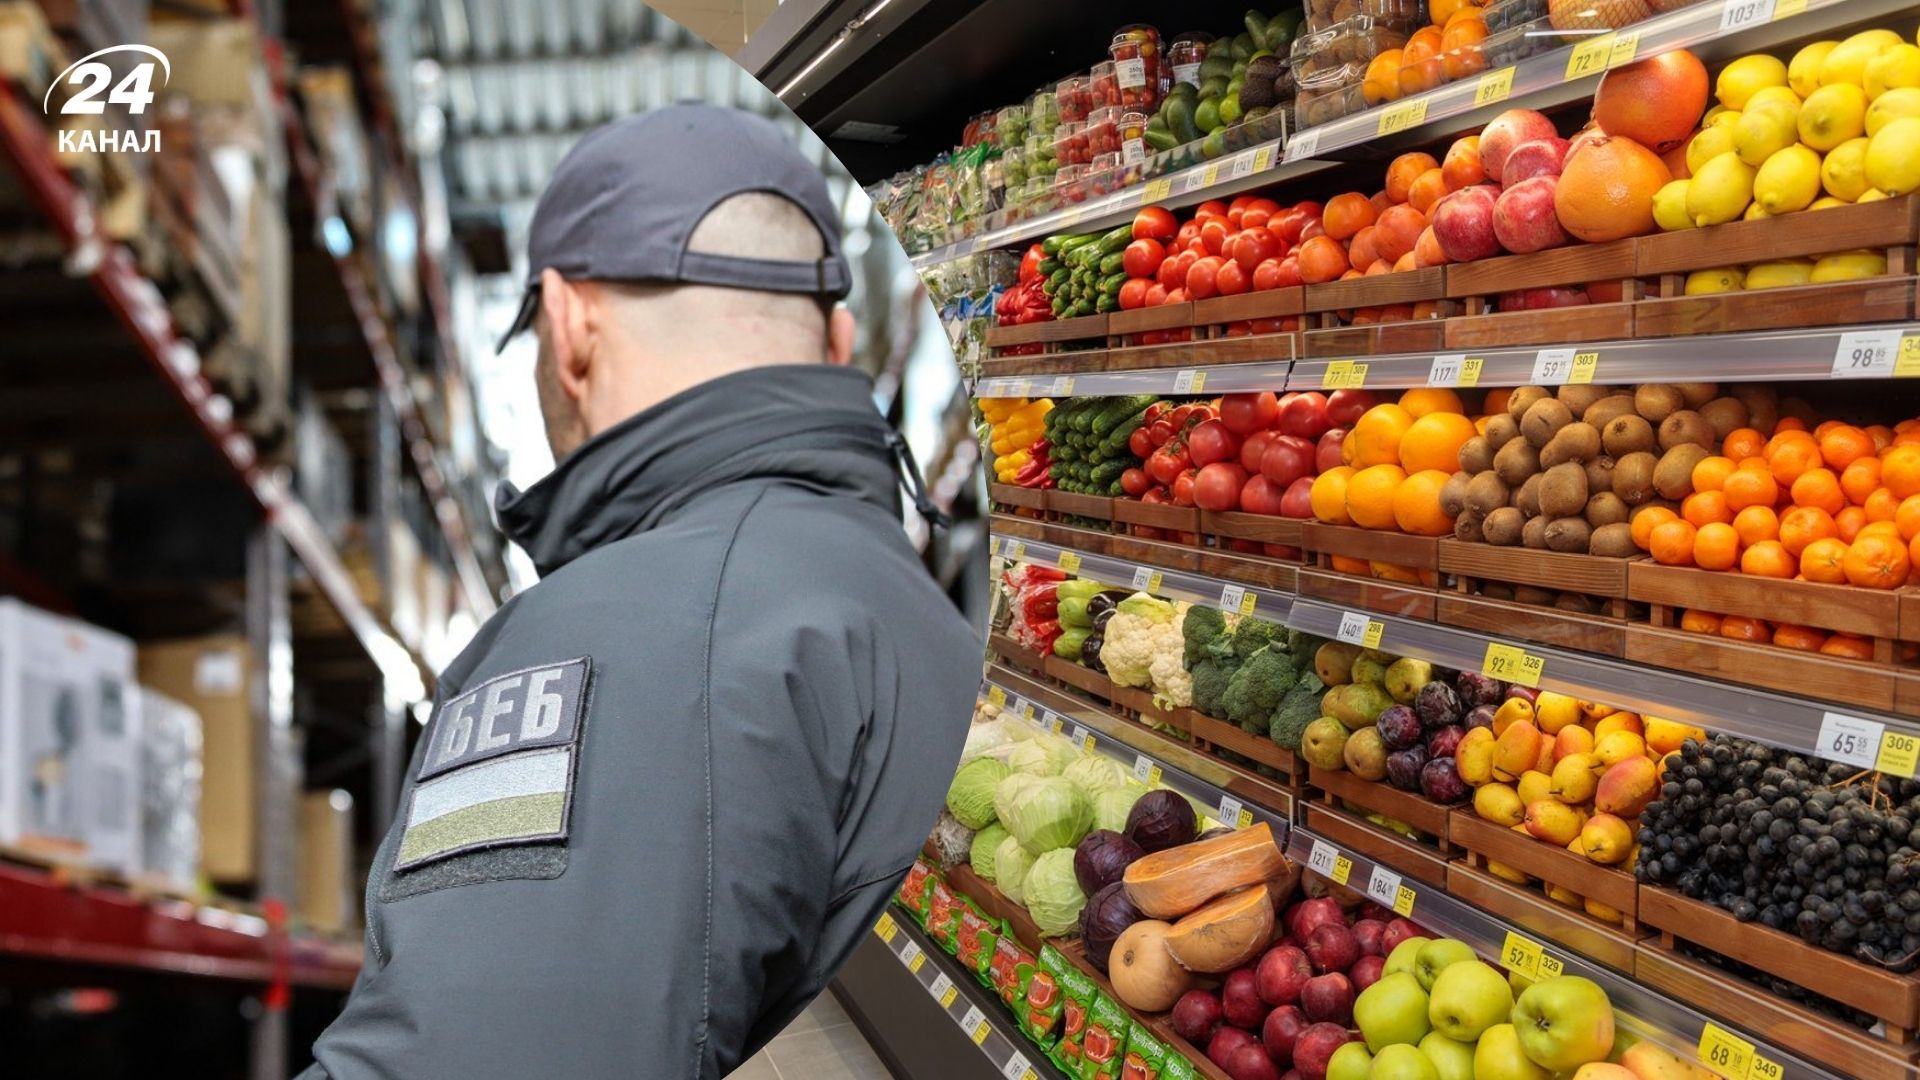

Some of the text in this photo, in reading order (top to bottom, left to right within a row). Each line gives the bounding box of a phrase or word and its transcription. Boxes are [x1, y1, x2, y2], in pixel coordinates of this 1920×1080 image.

[1727, 3, 1755, 26] 103
[1574, 54, 1591, 73] 72
[1483, 83, 1497, 100] 87
[1385, 114, 1397, 130] 87
[1464, 360, 1480, 371] 331
[1577, 355, 1595, 366] 303
[1852, 348, 1873, 368] 98
[1329, 371, 1341, 384] 77
[1433, 367, 1451, 381] 117
[1543, 361, 1558, 378] 59
[1342, 622, 1357, 637] 140
[1490, 657, 1505, 673] 92
[1524, 656, 1540, 670] 326
[433, 668, 563, 768] БЕБ
[1832, 733, 1856, 754] 65
[1886, 735, 1914, 752] 306
[1220, 805, 1233, 821] 119
[1312, 851, 1327, 867] 121
[1336, 858, 1349, 869] 234
[1372, 878, 1388, 896] 184
[1400, 887, 1413, 901] 325
[1509, 947, 1525, 967] 52
[1542, 957, 1559, 972] 329
[1710, 1044, 1730, 1066] 68
[1754, 1058, 1777, 1078] 349
